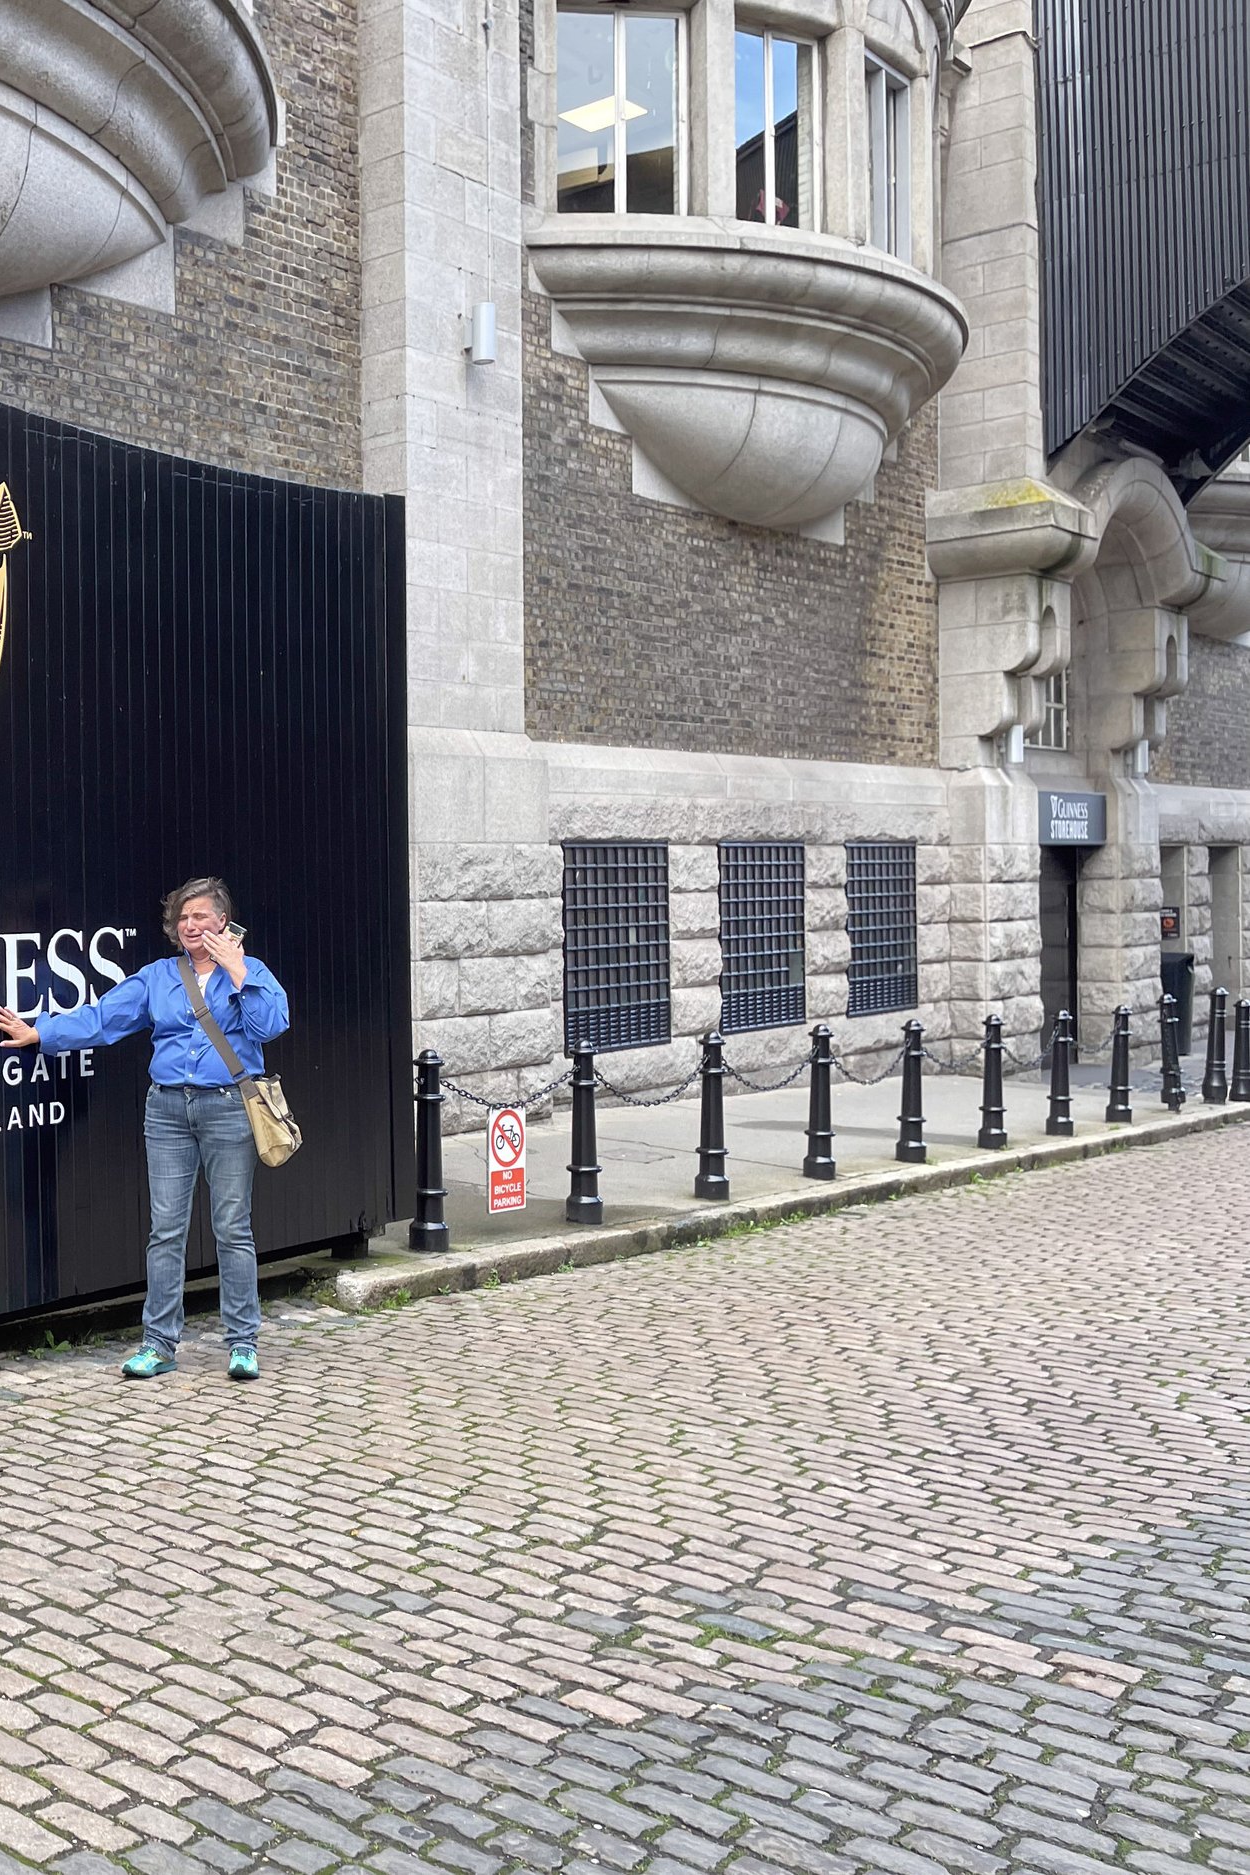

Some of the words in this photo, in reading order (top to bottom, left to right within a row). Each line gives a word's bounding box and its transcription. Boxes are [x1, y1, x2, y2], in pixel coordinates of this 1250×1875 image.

[1058, 798, 1088, 819] GUINNESS
[1050, 819, 1088, 839] STOREHOUSE
[2, 1049, 95, 1087] GATE
[502, 1170, 513, 1180] NO
[494, 1182, 522, 1195] BICYCLE
[493, 1196, 522, 1208] PARKING
